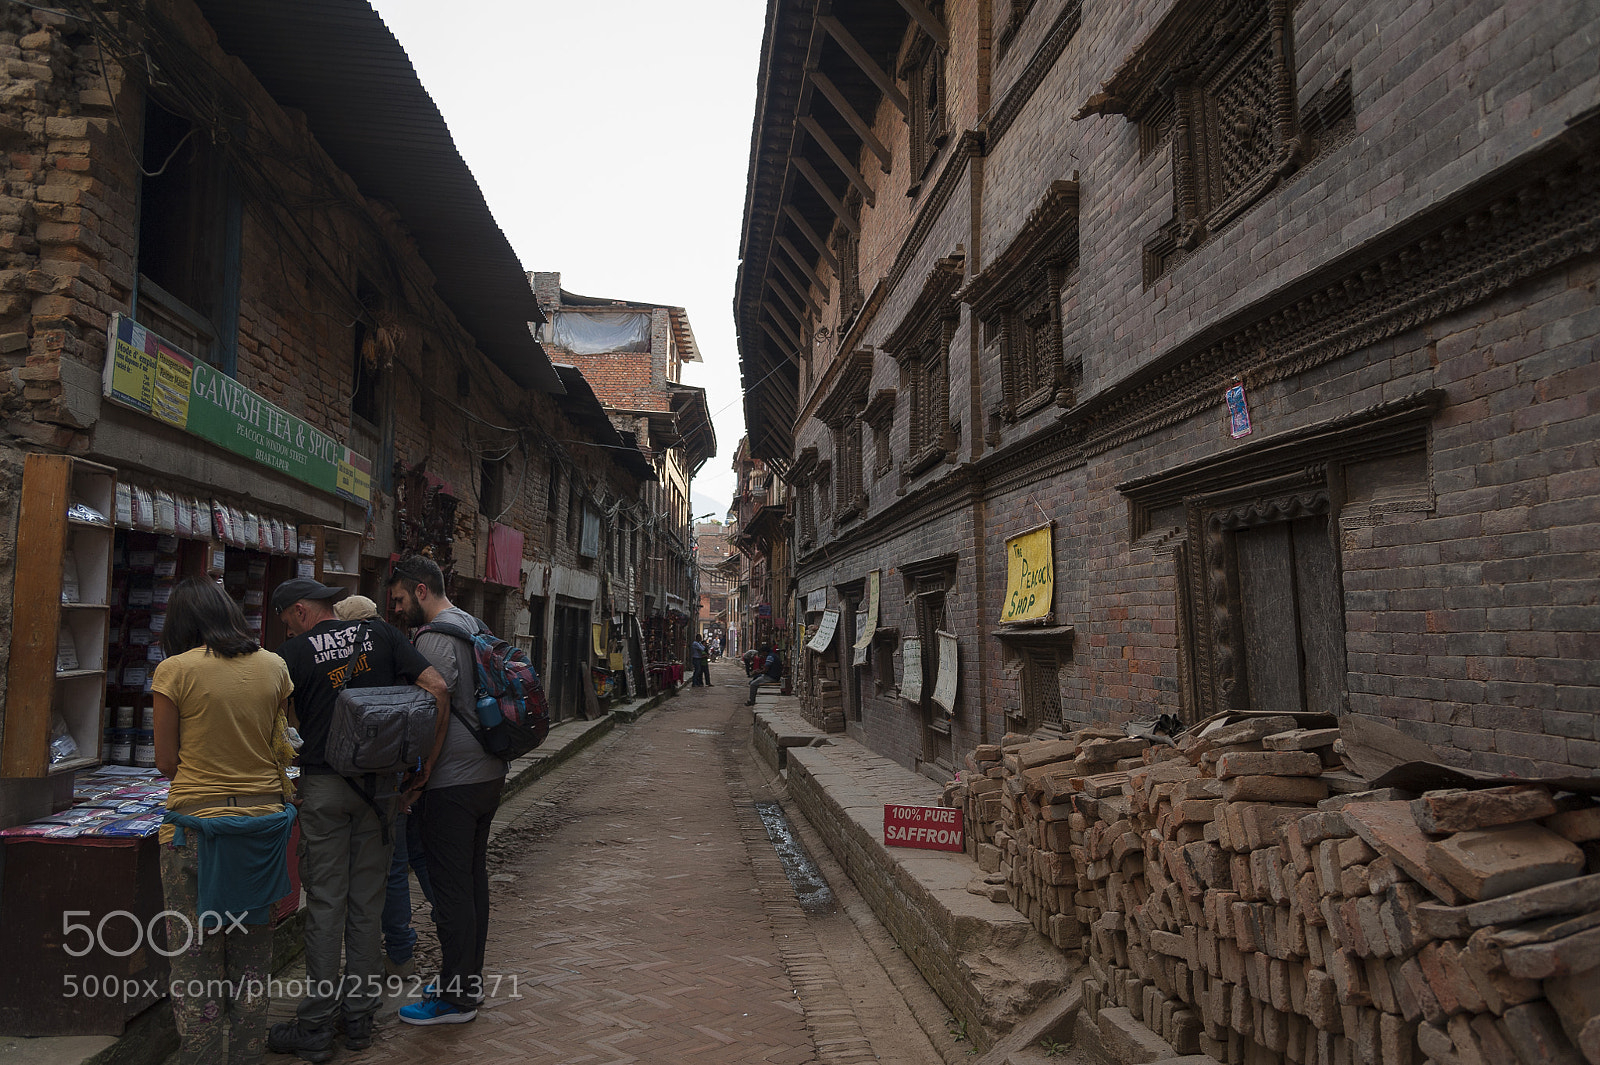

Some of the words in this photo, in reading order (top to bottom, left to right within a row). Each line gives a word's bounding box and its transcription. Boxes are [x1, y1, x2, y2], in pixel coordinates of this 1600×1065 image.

[193, 365, 261, 427] GANESH
[265, 406, 292, 443] TEA
[295, 424, 306, 449] &
[308, 429, 339, 467] SPICE
[236, 423, 265, 446] PEACOCK
[265, 437, 290, 457] WINDOW
[289, 449, 308, 465] STREET
[255, 449, 290, 472] BHAKTAPUR
[1008, 590, 1036, 617] SHOP
[892, 807, 921, 821] 100%
[924, 809, 956, 824] PURE
[886, 825, 962, 845] SAFFRON
